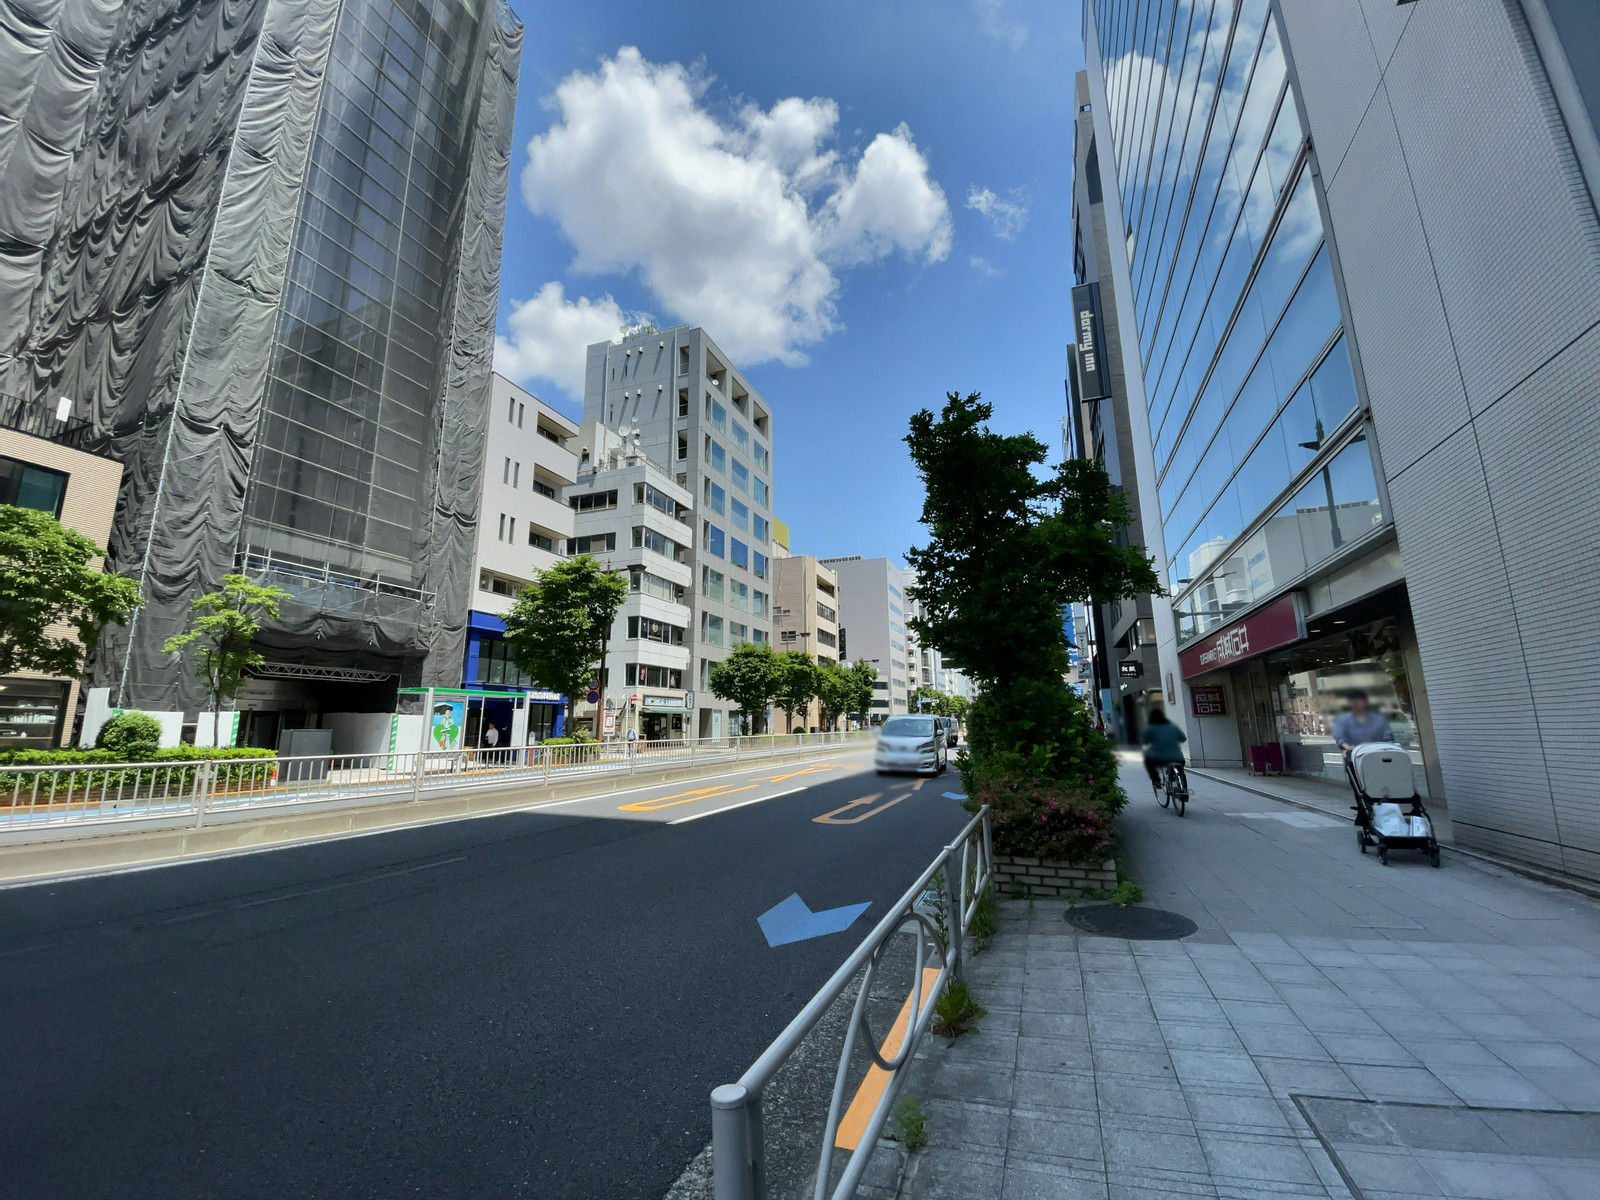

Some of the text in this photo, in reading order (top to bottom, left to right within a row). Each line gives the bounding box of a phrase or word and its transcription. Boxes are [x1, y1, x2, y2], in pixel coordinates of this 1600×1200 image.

[1079, 310, 1095, 372] dormy inn
[1216, 624, 1249, 662] 成城石井
